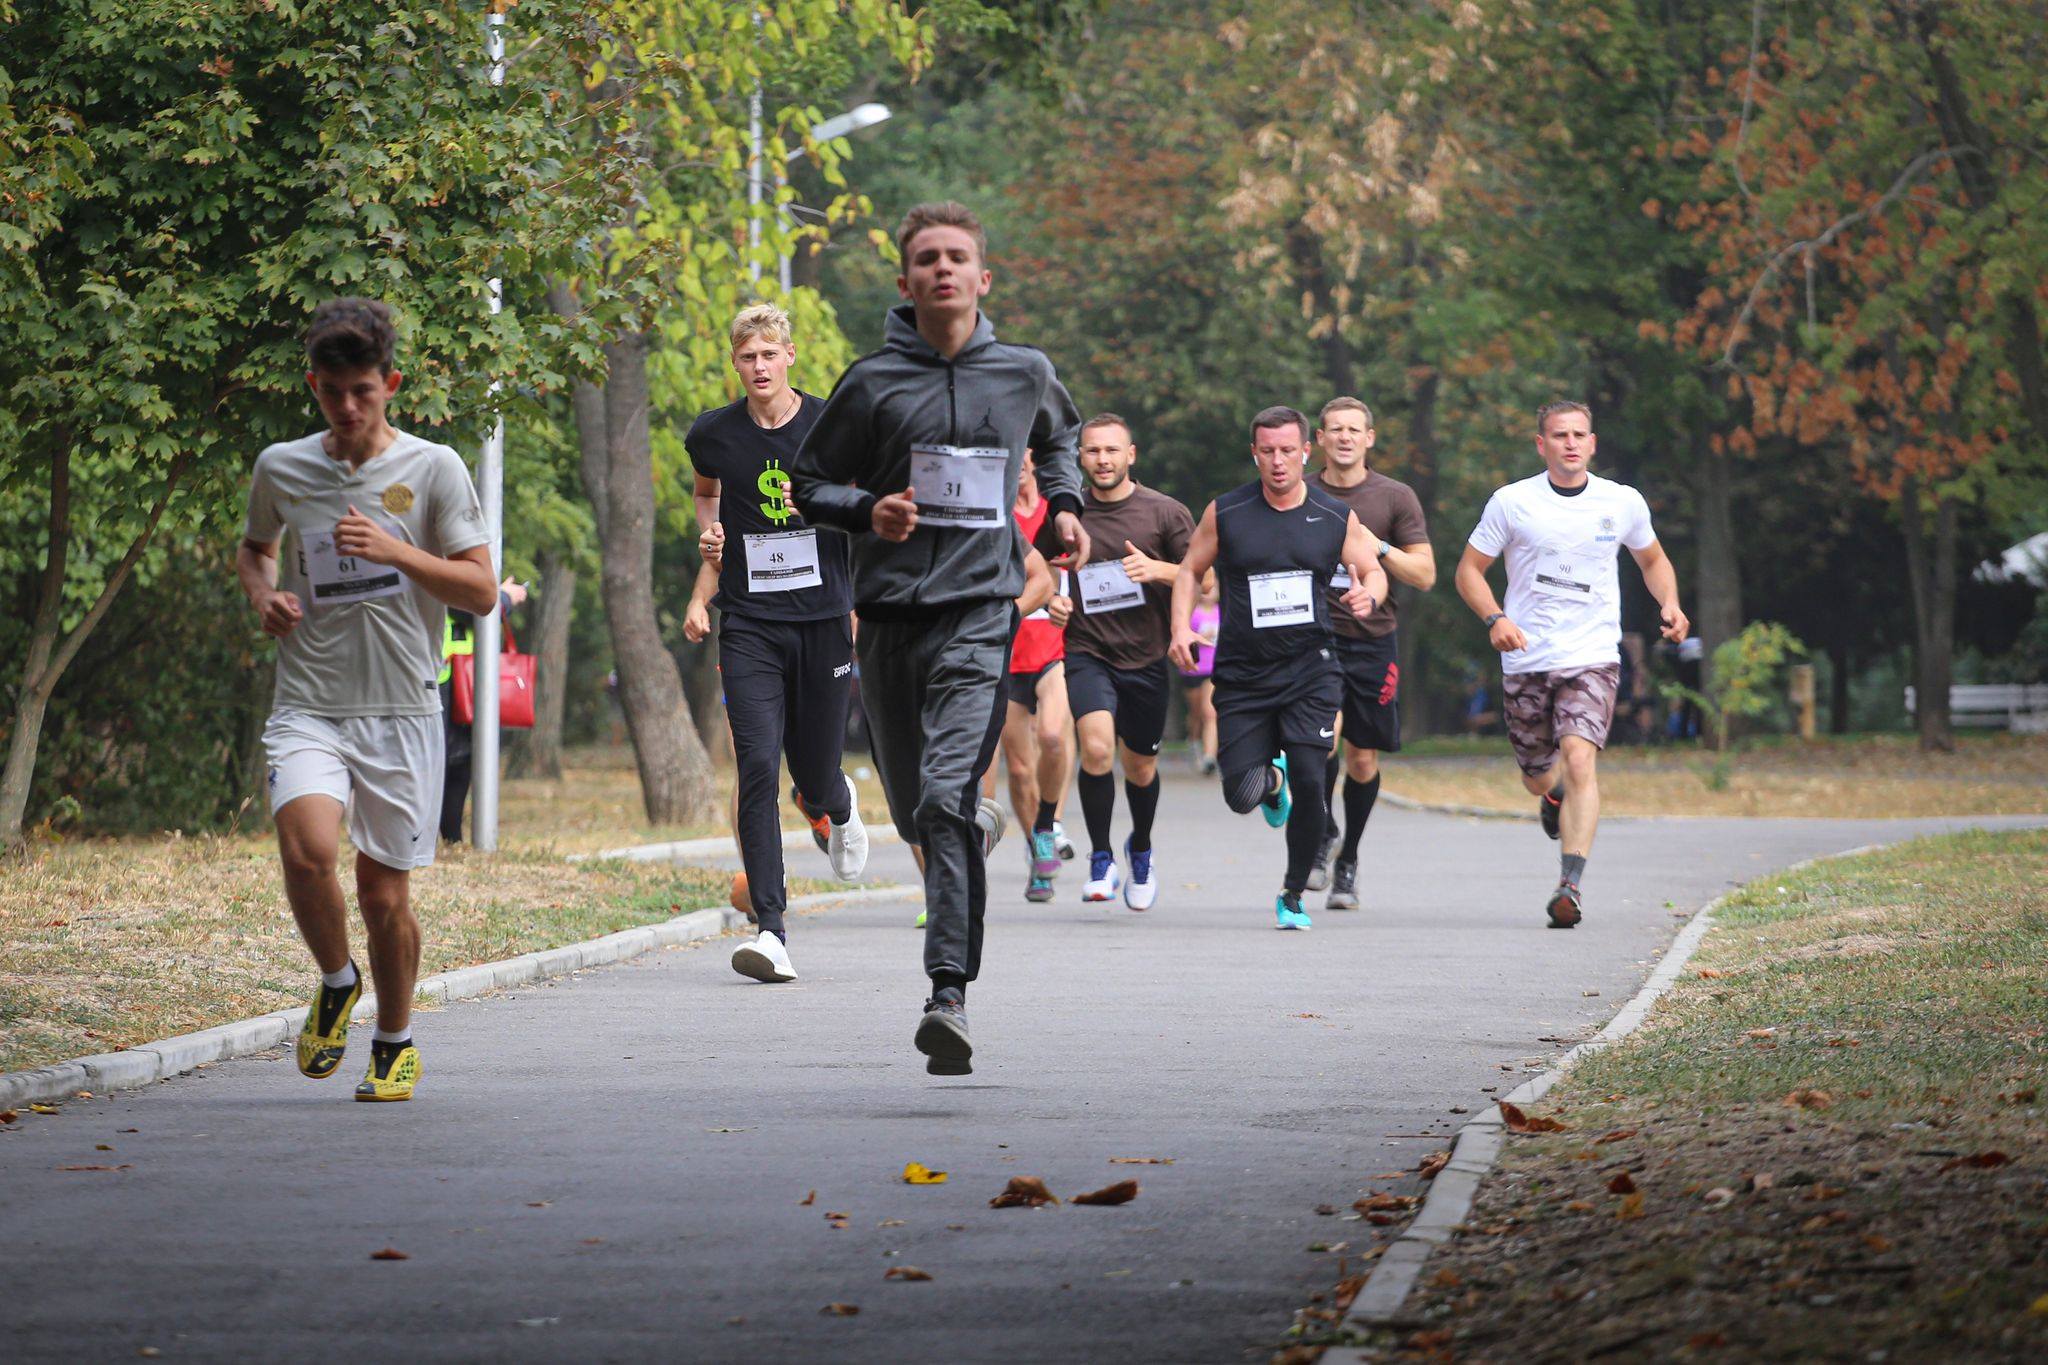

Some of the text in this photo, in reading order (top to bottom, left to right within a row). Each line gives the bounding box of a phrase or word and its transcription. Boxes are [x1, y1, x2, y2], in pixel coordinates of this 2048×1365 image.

[943, 481, 961, 497] 31
[769, 552, 784, 563] 48
[339, 557, 357, 572] 61
[1559, 563, 1572, 574] 90
[1098, 581, 1111, 592] 67
[1274, 591, 1287, 601] 16
